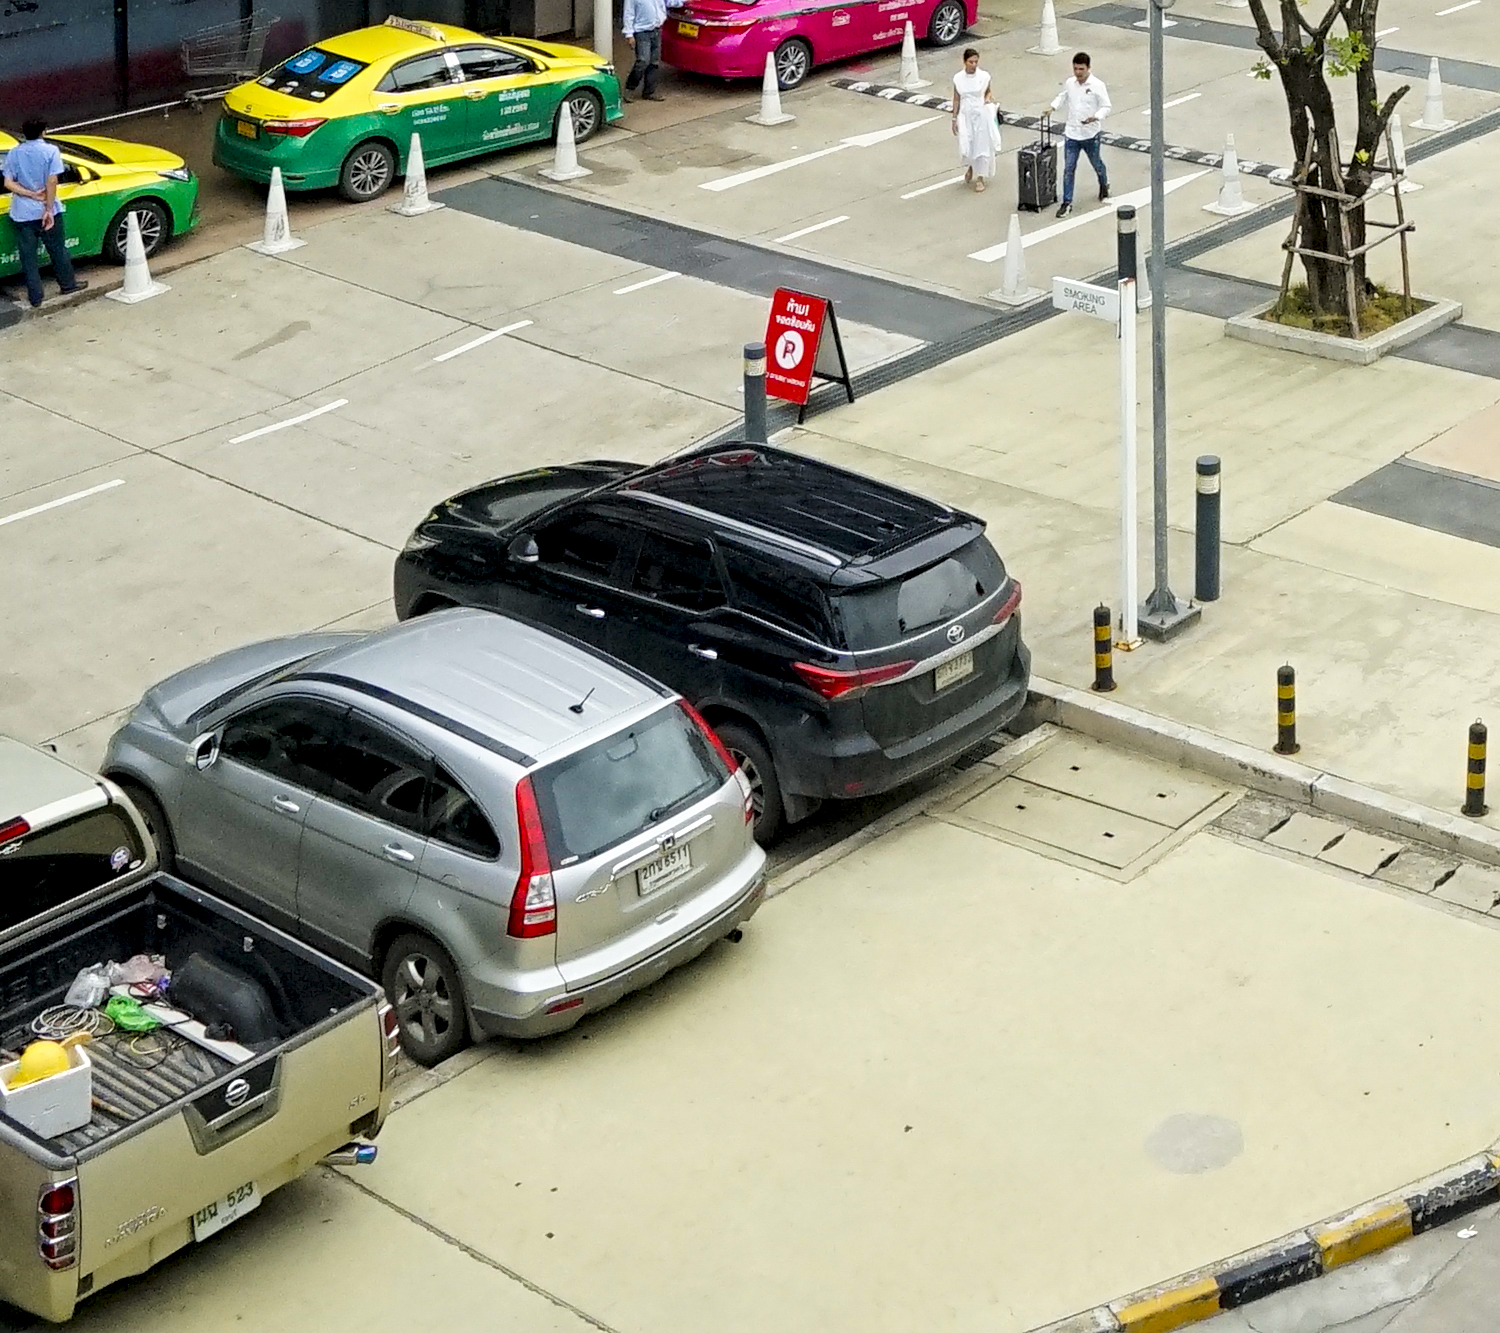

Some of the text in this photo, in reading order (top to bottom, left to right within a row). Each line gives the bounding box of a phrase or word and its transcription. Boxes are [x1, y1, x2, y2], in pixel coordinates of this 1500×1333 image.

[1063, 287, 1106, 306] SMOKING
[1072, 300, 1098, 315] AREA
[227, 1181, 254, 1208] 523
